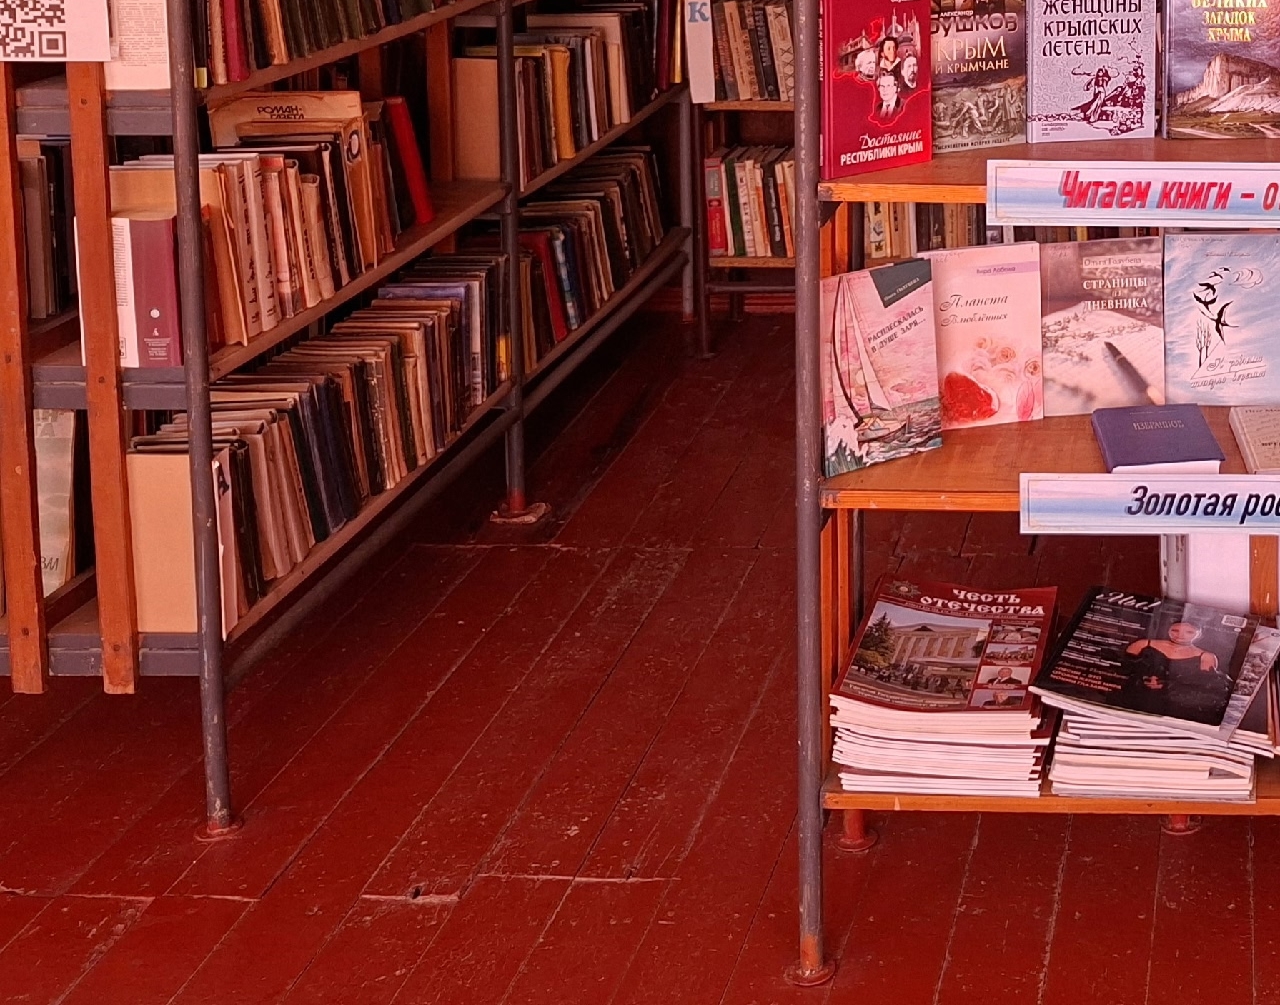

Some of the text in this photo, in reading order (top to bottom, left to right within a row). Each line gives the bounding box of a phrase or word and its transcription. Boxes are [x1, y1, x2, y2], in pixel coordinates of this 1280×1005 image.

[688, 1, 710, 23] К
[1203, 10, 1256, 26] ЗАГАДОК
[1044, 18, 1142, 37] КРЫМСКИХ
[1208, 27, 1252, 43] КРЫМА
[935, 35, 1007, 62] КРЫМ
[1043, 39, 1111, 56] ЛЕГЕНД
[935, 59, 1009, 74] И КРЫМЧАНЕ
[859, 129, 922, 150] Достояние
[840, 140, 924, 167] РЕСПУБЛИКИ КРЫМ
[1060, 170, 1150, 211] Читаем
[1157, 178, 1233, 211] книги
[1082, 277, 1148, 290] СТРАНИЦЫ
[1084, 297, 1148, 312] ДНЕВНИКА
[867, 305, 924, 344] РАСПЛЕСКАЛАСЬ
[1127, 486, 1238, 518] Золотая
[920, 596, 1045, 615] ОТЕЧЕСТВА
[953, 588, 1021, 604] ЧЕСТЬ
